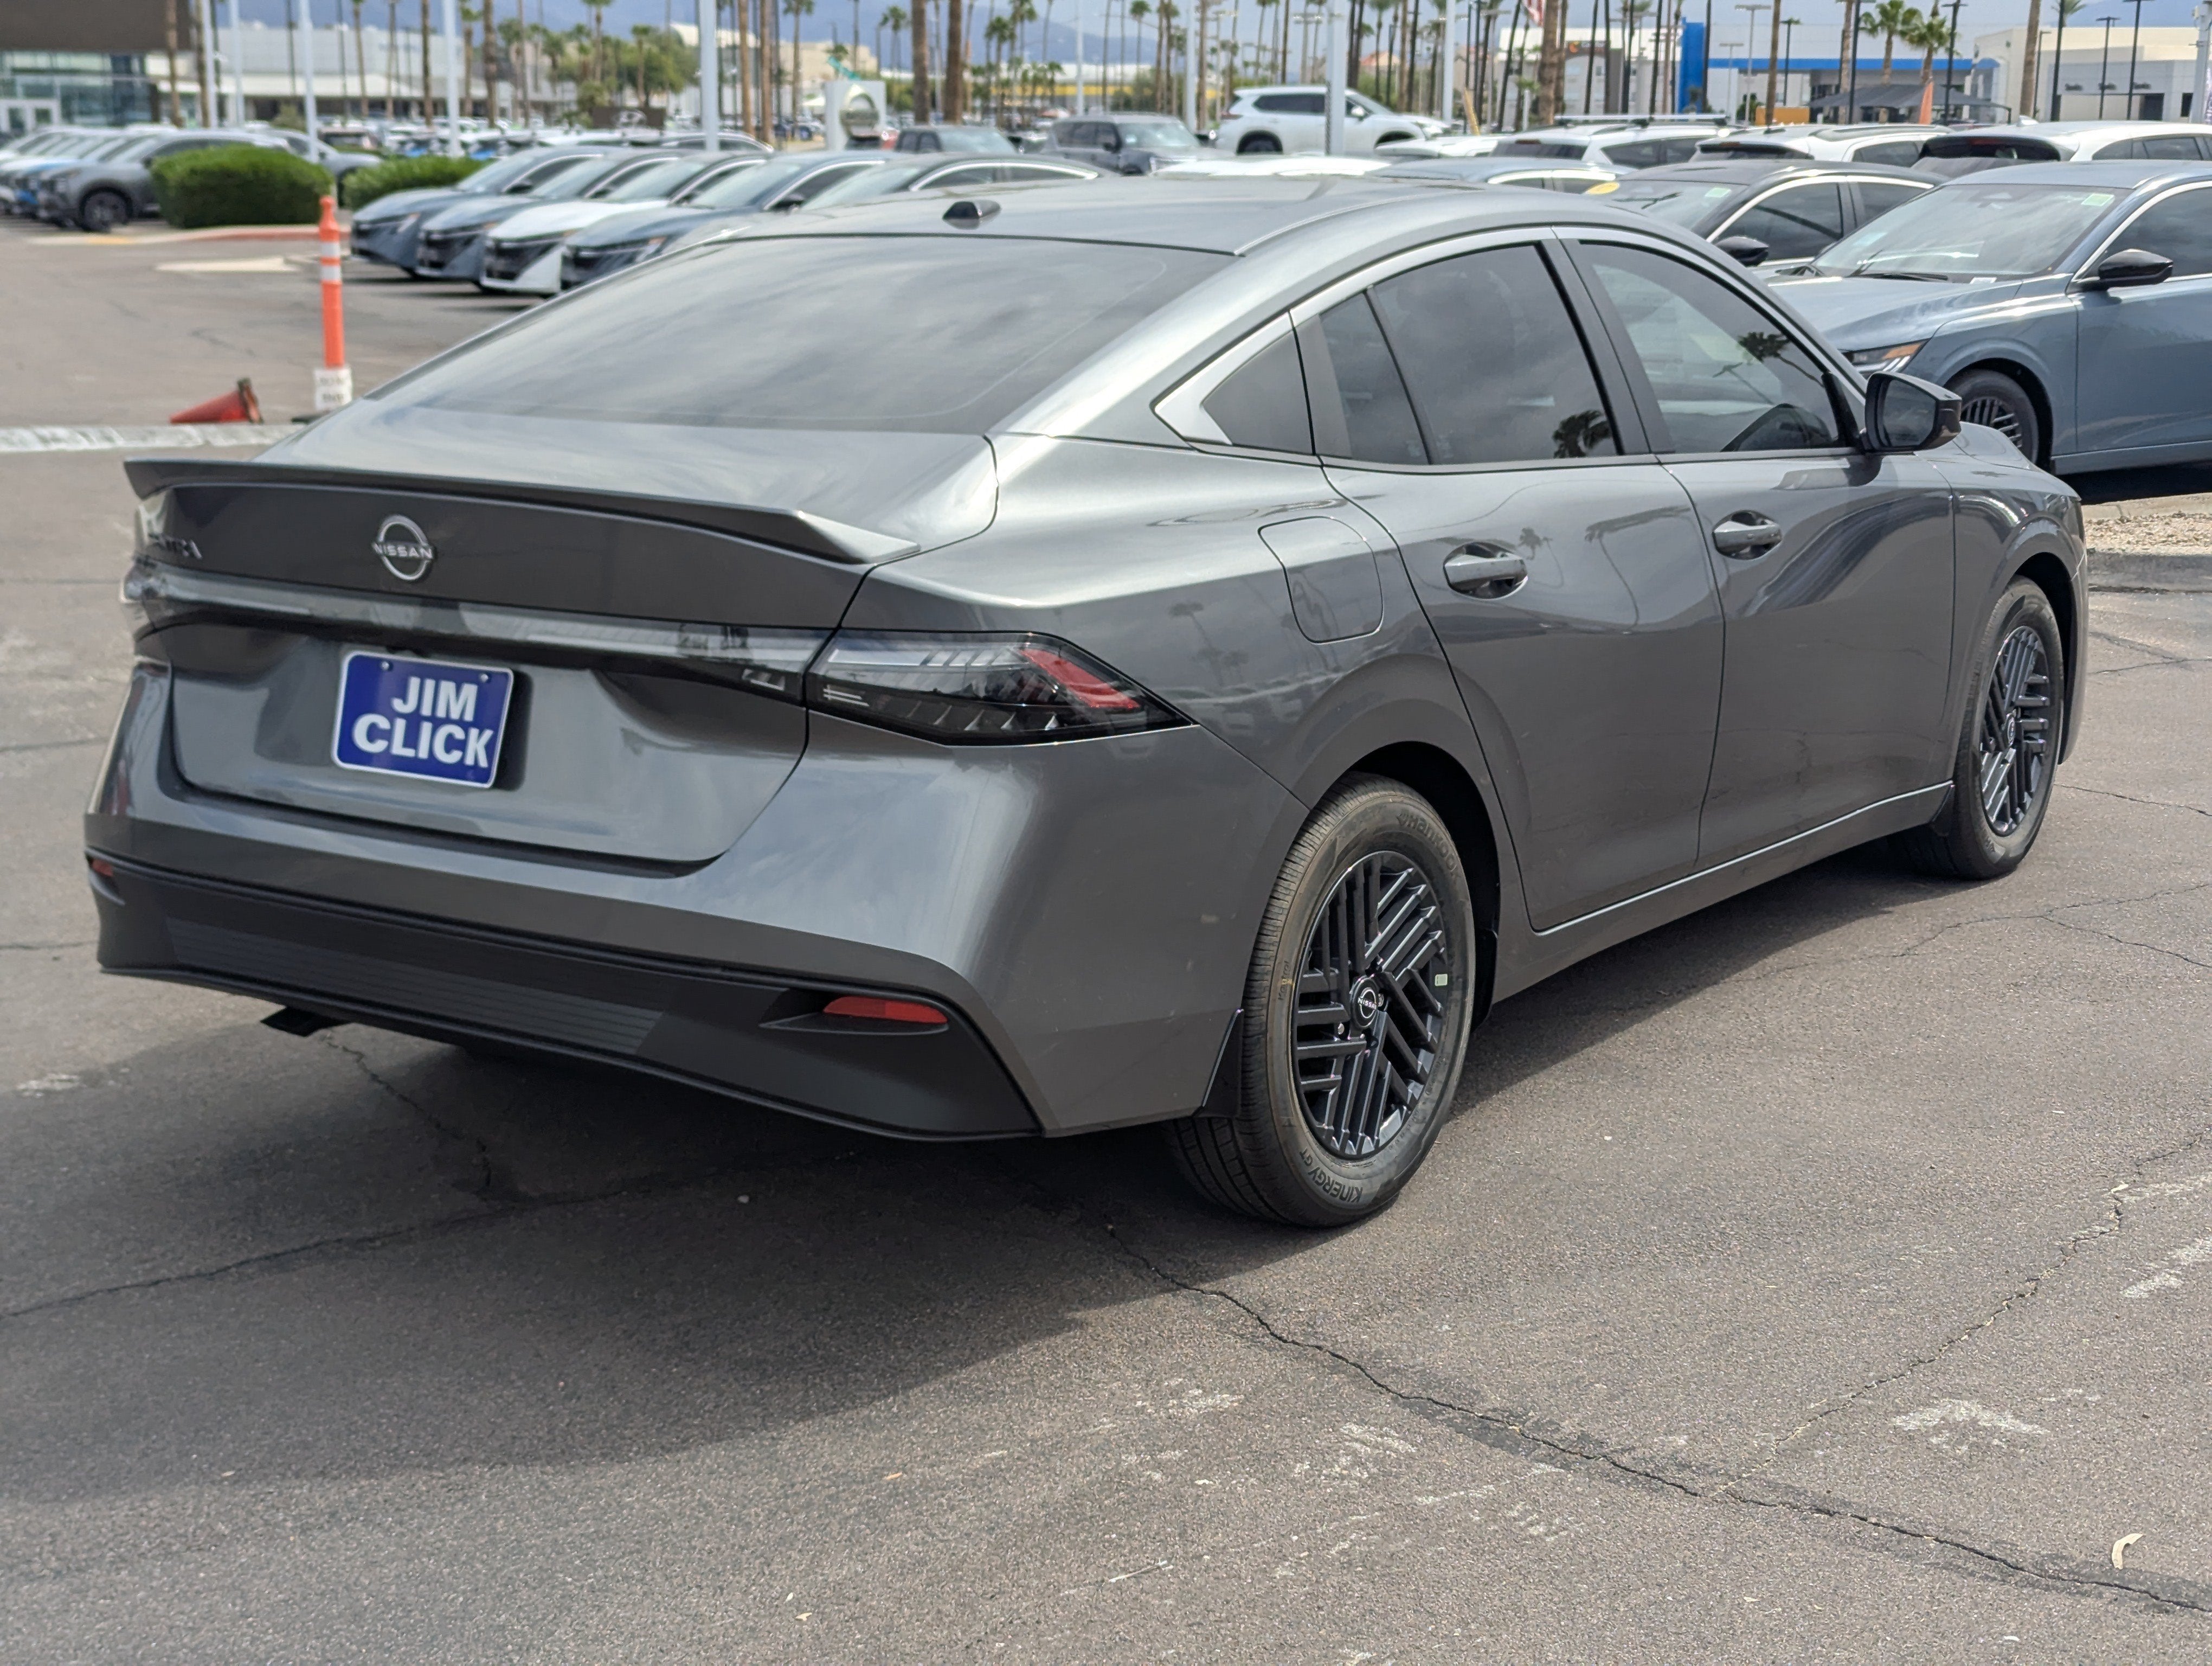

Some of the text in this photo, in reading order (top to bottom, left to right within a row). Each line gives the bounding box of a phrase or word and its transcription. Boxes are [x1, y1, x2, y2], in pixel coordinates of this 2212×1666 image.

[371, 542, 433, 559] NISSAN
[391, 676, 478, 722] JIM
[353, 713, 494, 768] CLICK
[1300, 1148, 1363, 1203] KINERGY GT
